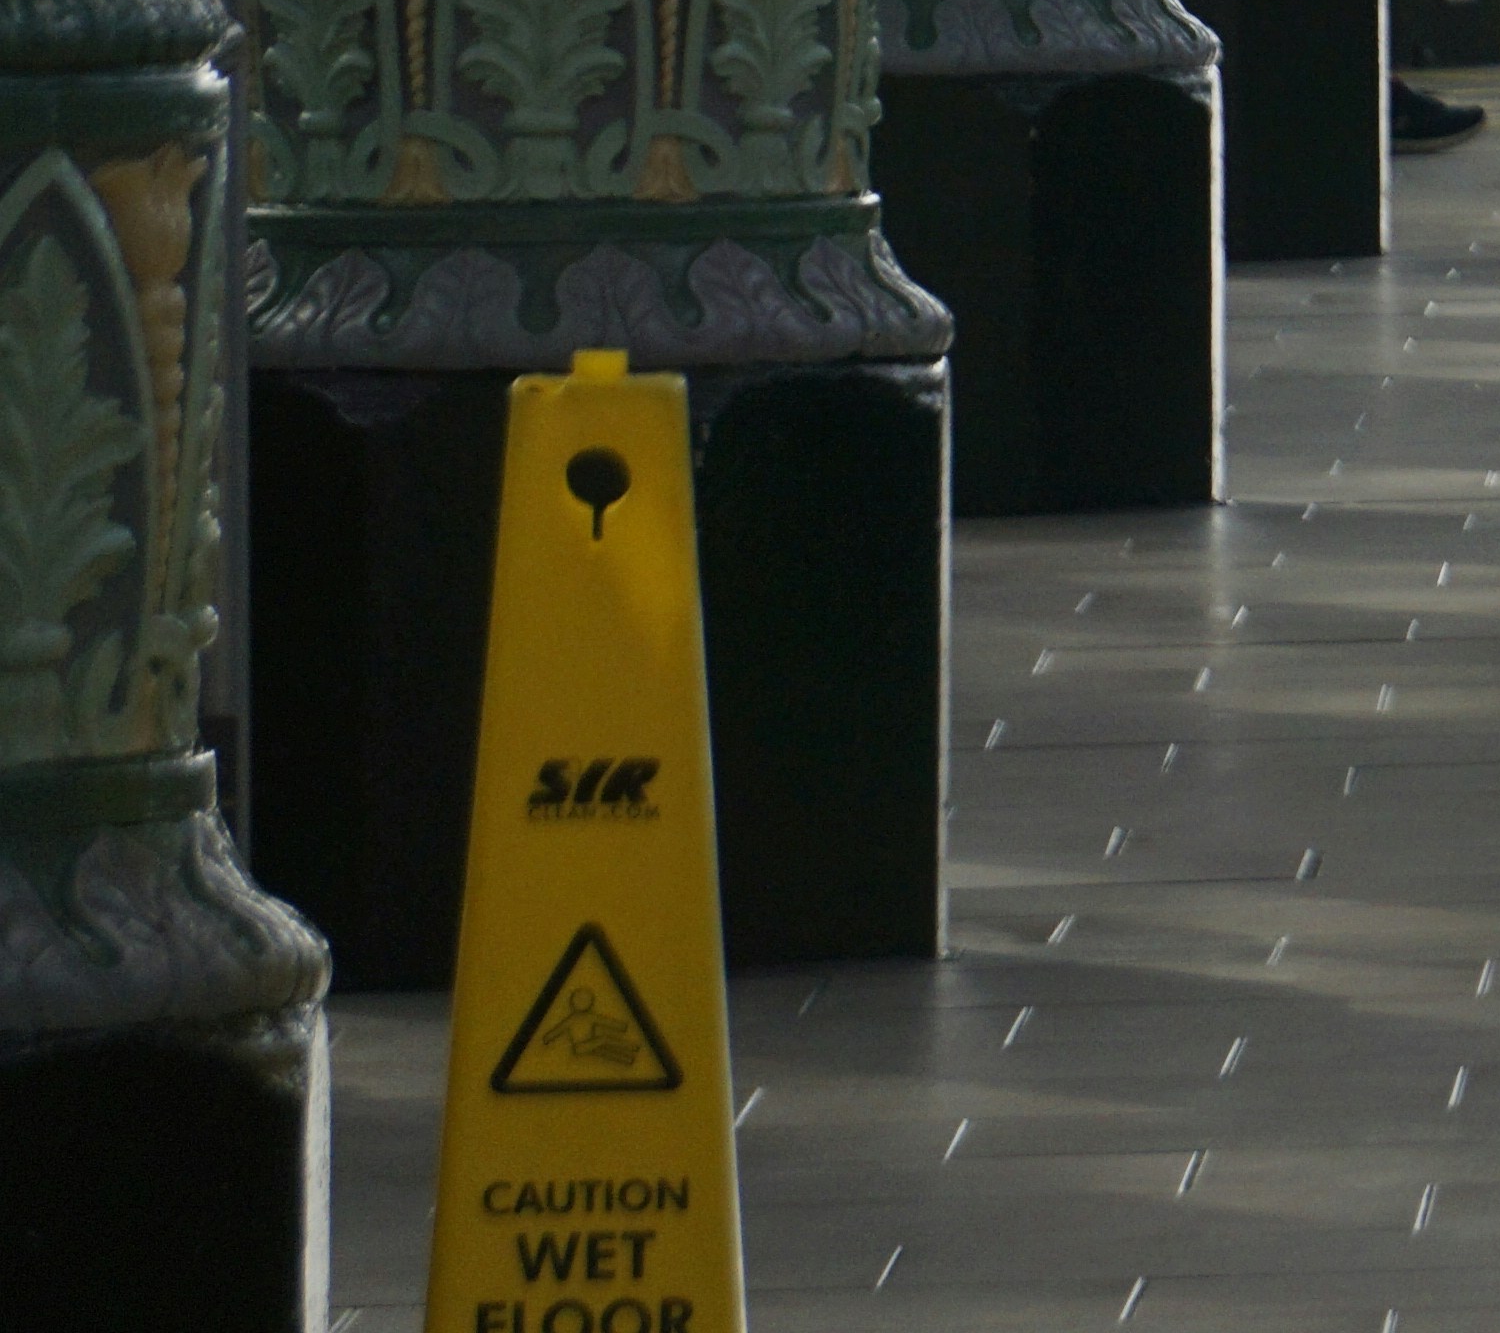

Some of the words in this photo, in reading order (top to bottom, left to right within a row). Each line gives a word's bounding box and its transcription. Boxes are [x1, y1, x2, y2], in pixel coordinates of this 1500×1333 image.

[528, 756, 662, 805] SIR
[482, 1176, 691, 1216] CAUTION
[516, 1230, 658, 1283] WET
